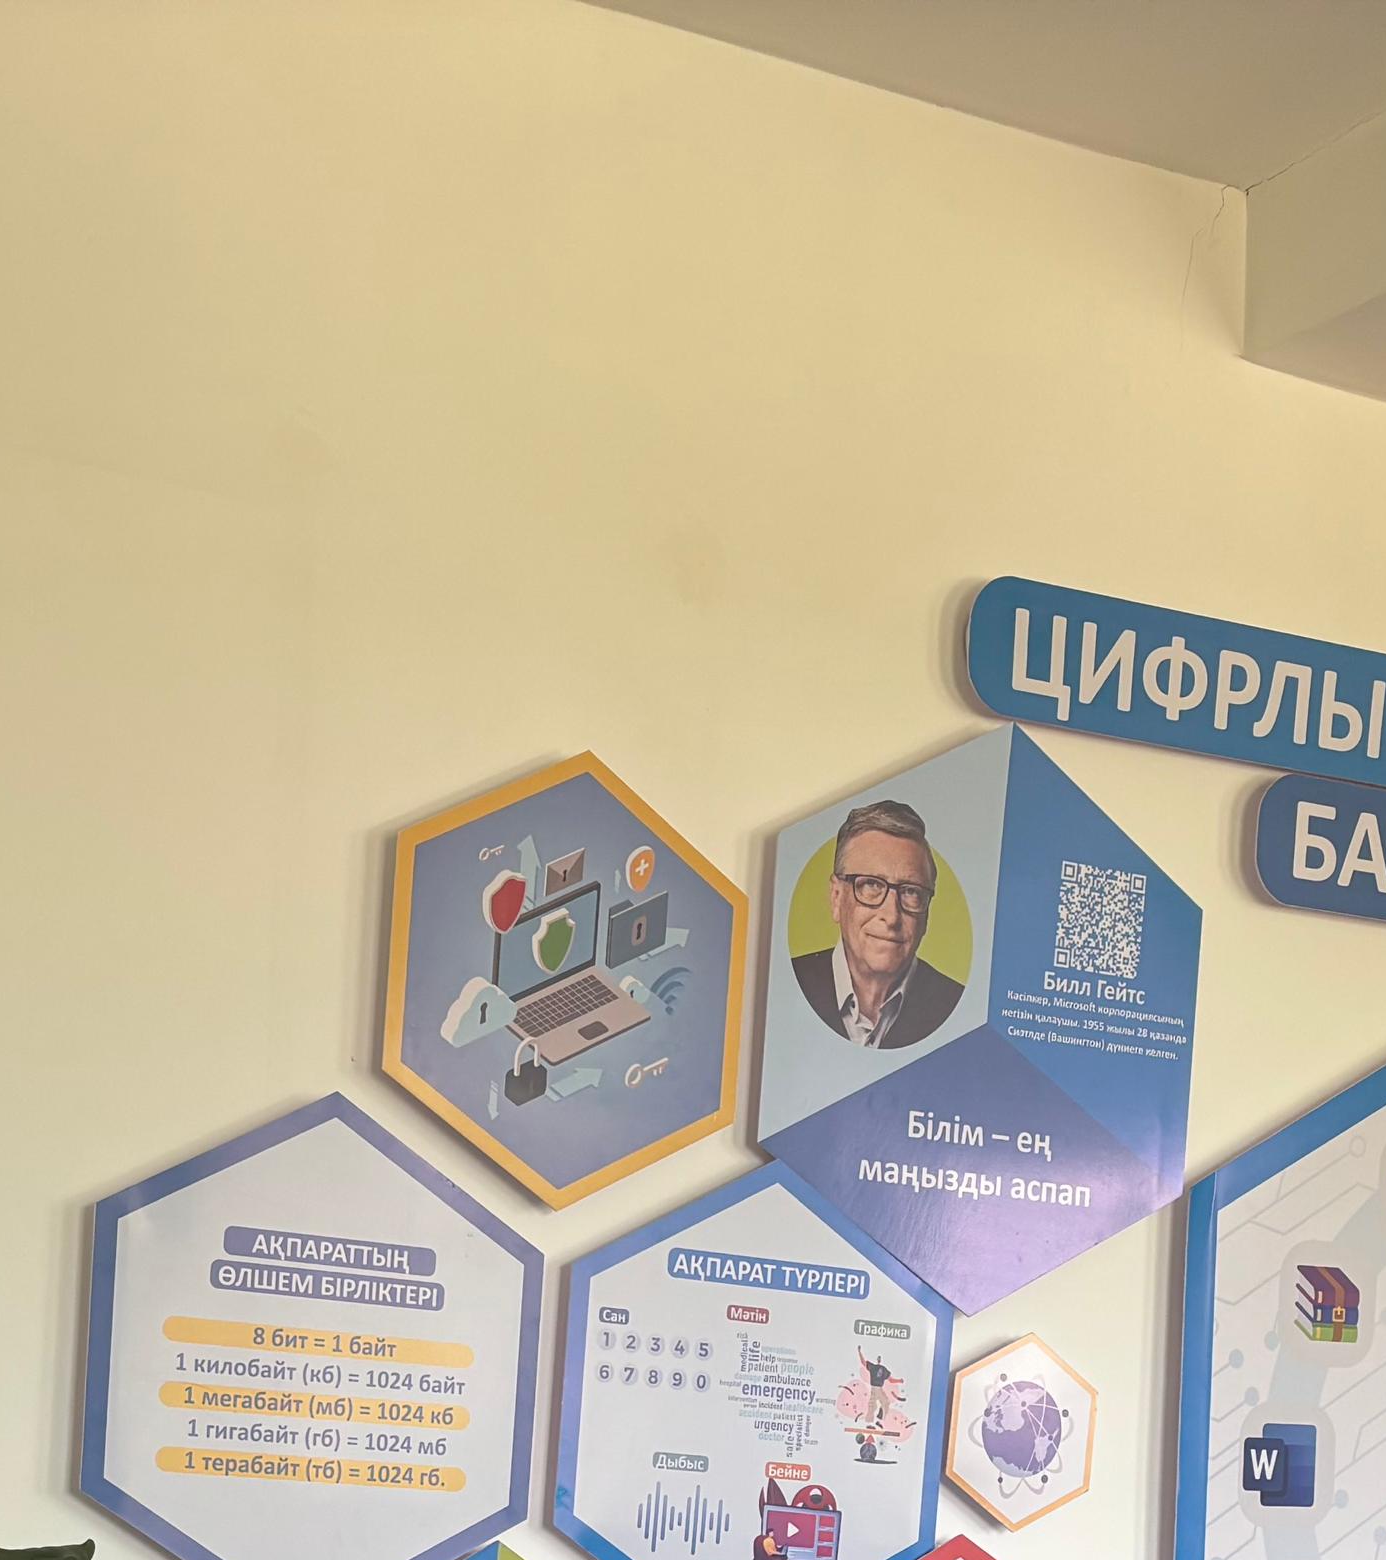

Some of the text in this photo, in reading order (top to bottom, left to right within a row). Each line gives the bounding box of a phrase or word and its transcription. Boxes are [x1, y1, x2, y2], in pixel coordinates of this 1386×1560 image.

[1011, 607, 1386, 759] ЦИФРЛЫ
[1044, 971, 1145, 1004] Билл Гейтс
[1008, 990, 1051, 1007] Кәсіпкер,
[1053, 998, 1096, 1013] Microsoft
[1035, 1014, 1081, 1028] қалаушы.
[1083, 1019, 1104, 1031] 1955
[1106, 1024, 1135, 1036] жылы
[1136, 1028, 1148, 1038] 28
[1047, 1031, 1105, 1051] (Вашингтон)
[907, 1110, 985, 1148] Білім
[1017, 1133, 1051, 1163] ең
[858, 1160, 1091, 1208] маңызды аспап
[252, 1234, 409, 1274] АҚПАРАТТЫҢ
[218, 1265, 437, 1307] ӨЛШЕМ БІРЛІКТЕРІ
[673, 1252, 867, 1296] АҚПАРАТ ТҮРЛЕРІ
[603, 1310, 626, 1323] Сан
[730, 1307, 766, 1322] Мәтін
[857, 1321, 909, 1339] Графика
[253, 1328, 397, 1357] 8 бит = 1 байт
[603, 1332, 708, 1357] 1 2 3 4 5
[749, 1341, 761, 1362] life
[748, 1362, 778, 1373] patient
[761, 1354, 776, 1363] help
[781, 1364, 814, 1375] people
[175, 1353, 465, 1395] 1 килобайт (кб) = 1024 байт
[599, 1365, 706, 1389] 6 7 8 9 0
[763, 1374, 811, 1387] ambulance
[185, 1386, 453, 1425] 1 мегабайт (мб) = 1024 кб
[742, 1383, 816, 1405] emergency
[188, 1419, 447, 1456] 1 гигабайт (гб) = 1024 мб
[754, 1420, 794, 1434] urgency
[185, 1452, 445, 1487] 1 терабайт (тб) = 1024 гб.
[656, 1455, 704, 1470] Дыбыс
[768, 1464, 808, 1479] Бейне
[1250, 1449, 1277, 1481] W
